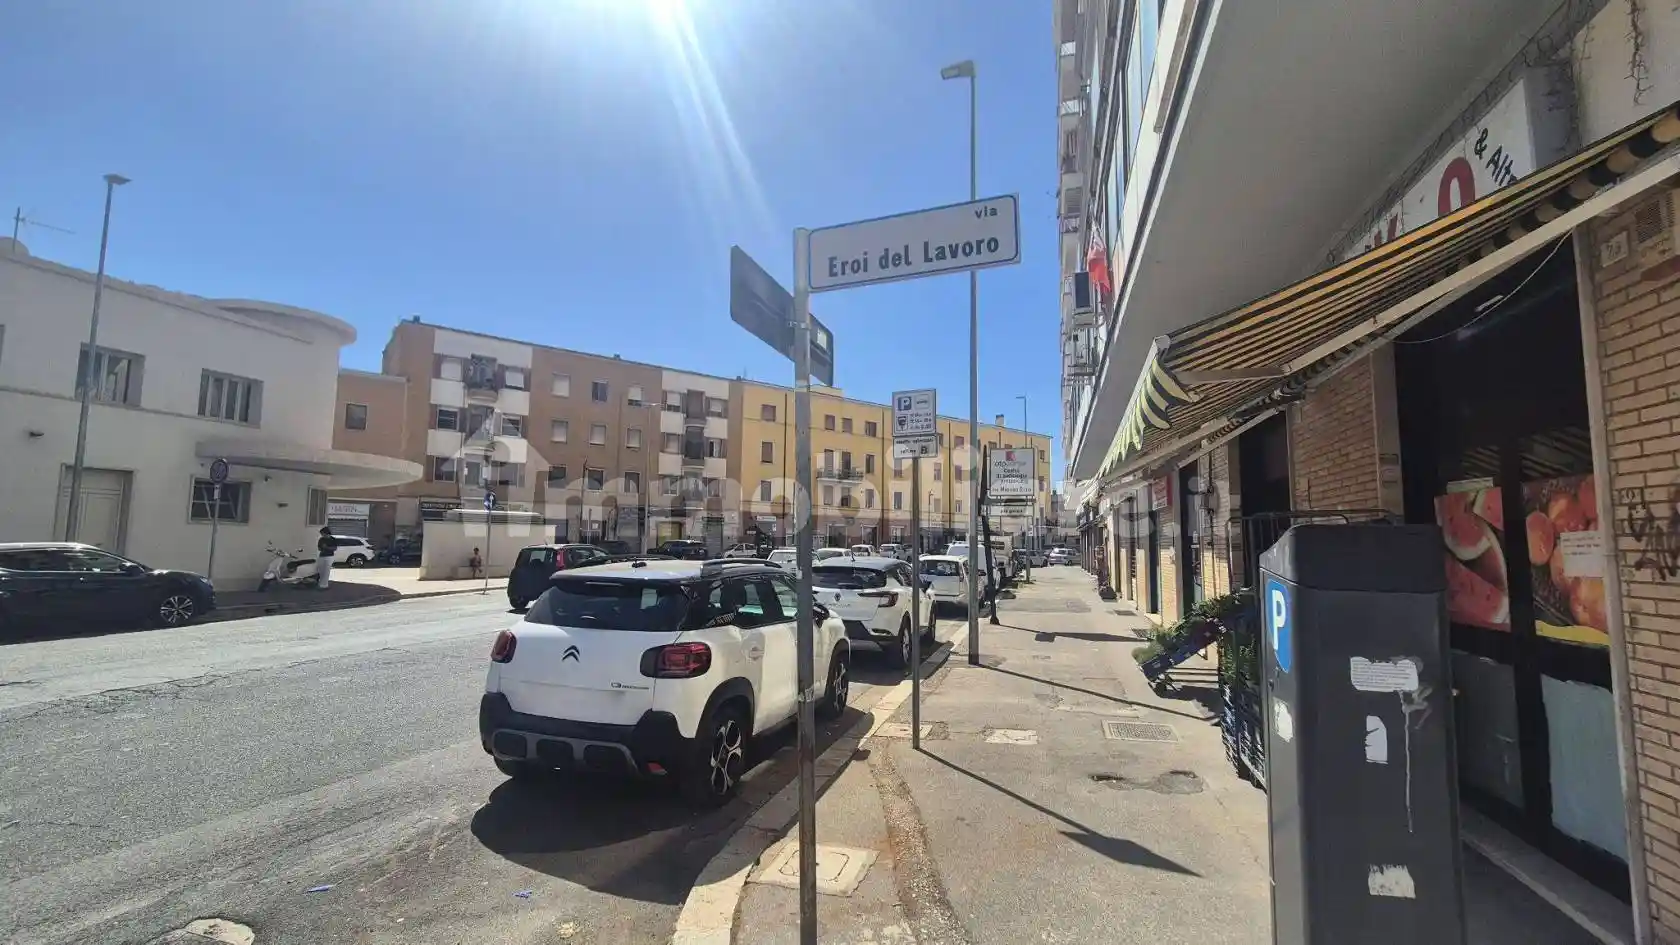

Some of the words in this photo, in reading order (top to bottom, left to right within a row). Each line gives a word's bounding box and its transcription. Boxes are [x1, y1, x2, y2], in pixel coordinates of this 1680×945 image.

[974, 206, 998, 219] via
[828, 251, 868, 277] Eroi
[878, 245, 912, 269] del
[923, 236, 999, 263] Lavoro
[1271, 590, 1286, 651] P
